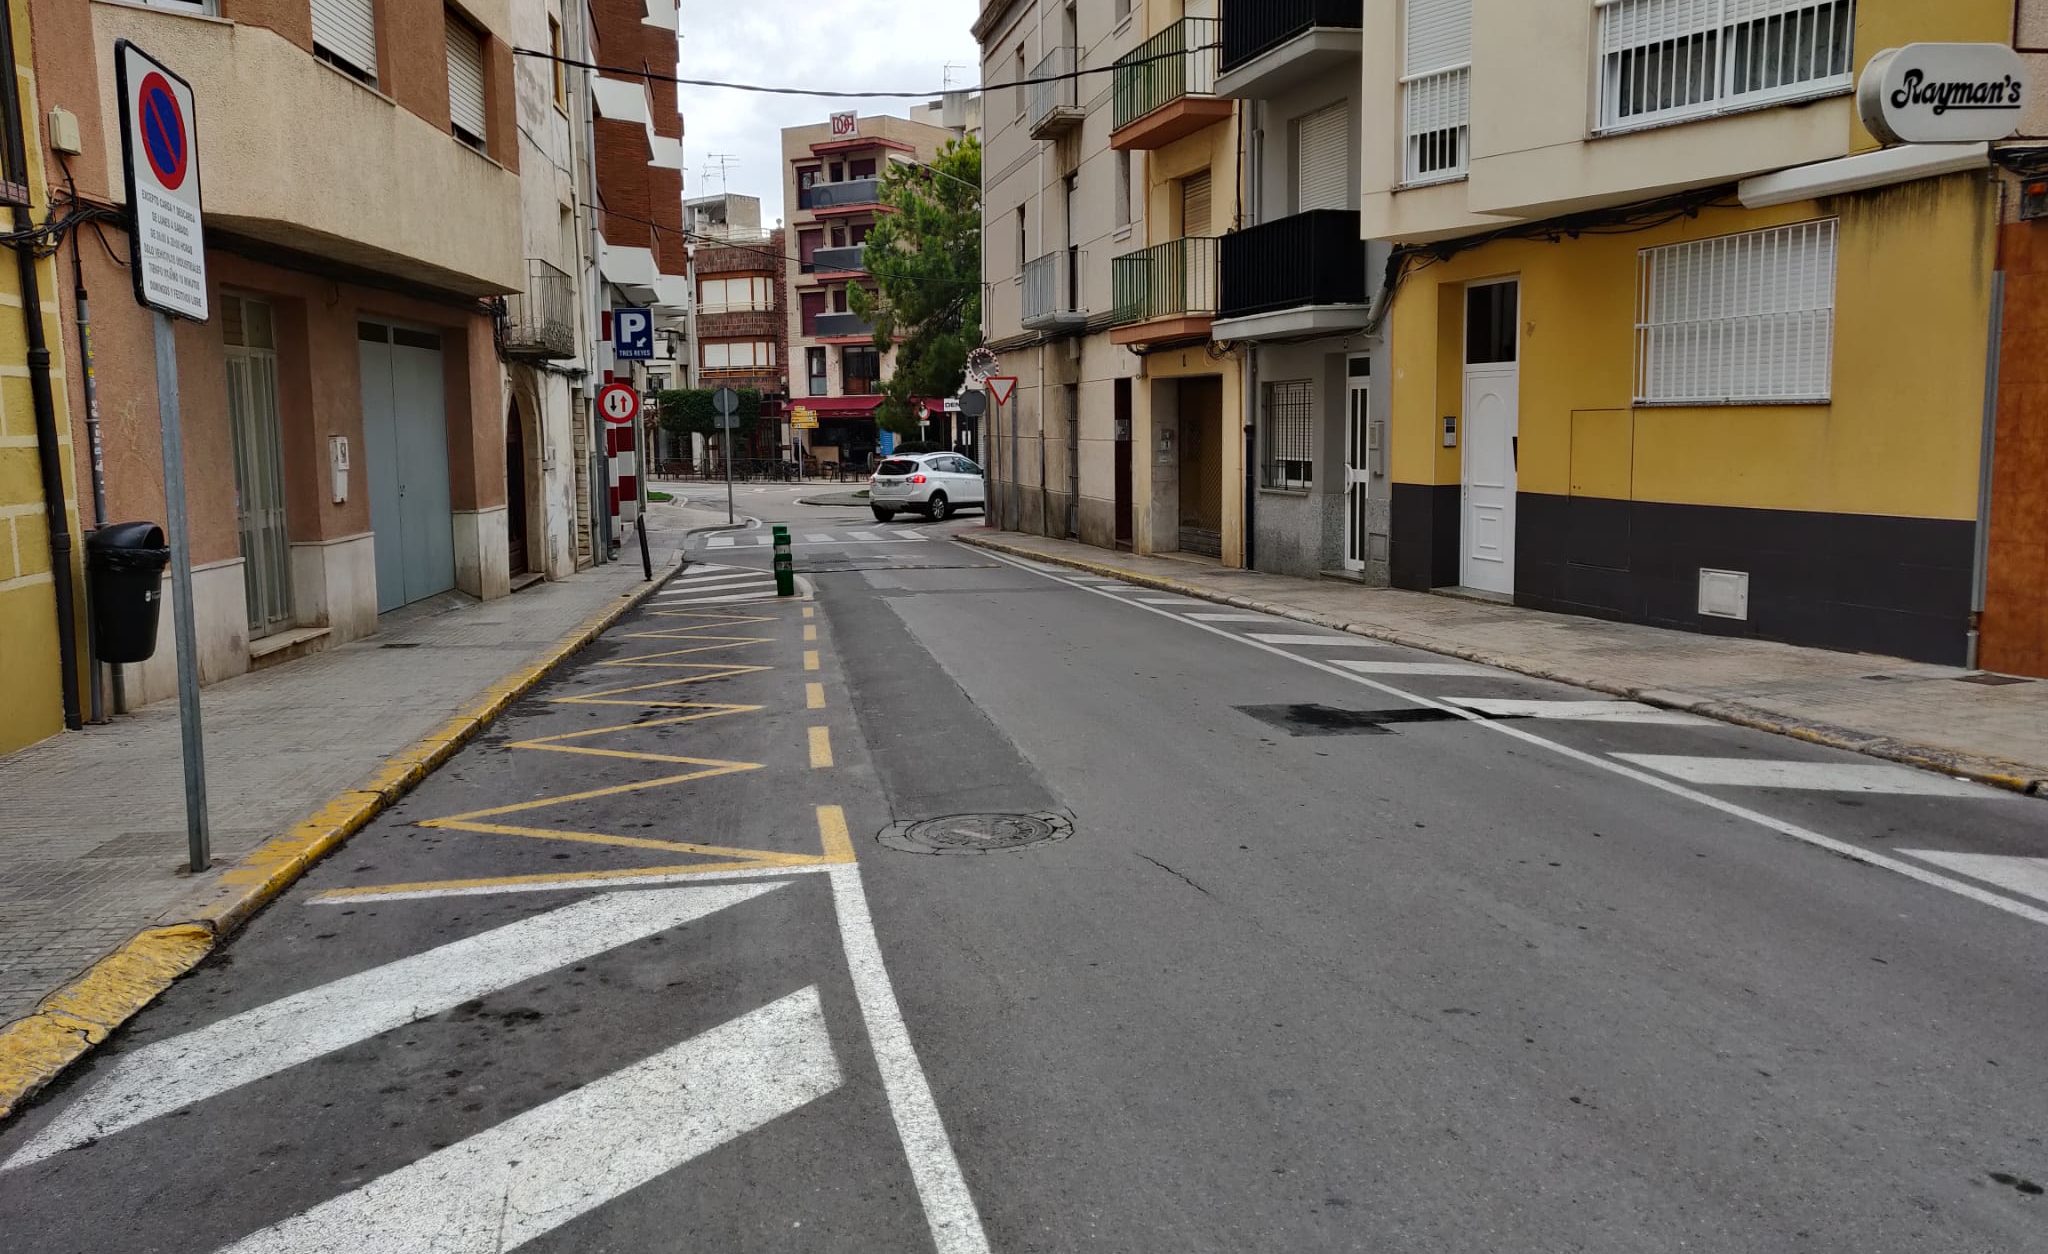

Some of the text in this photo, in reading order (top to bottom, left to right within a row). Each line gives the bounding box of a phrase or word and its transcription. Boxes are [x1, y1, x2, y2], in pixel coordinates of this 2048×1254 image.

[1891, 68, 2022, 116] Rayman's
[142, 189, 159, 206] EXCEPTO
[160, 198, 172, 212] CARGA
[176, 206, 195, 223] DESCARGA
[158, 214, 170, 228] LUNES
[181, 241, 193, 255] HORAS
[149, 262, 163, 277] TIEMPO
[150, 280, 170, 296] DOMINGOS
[620, 313, 646, 343] P
